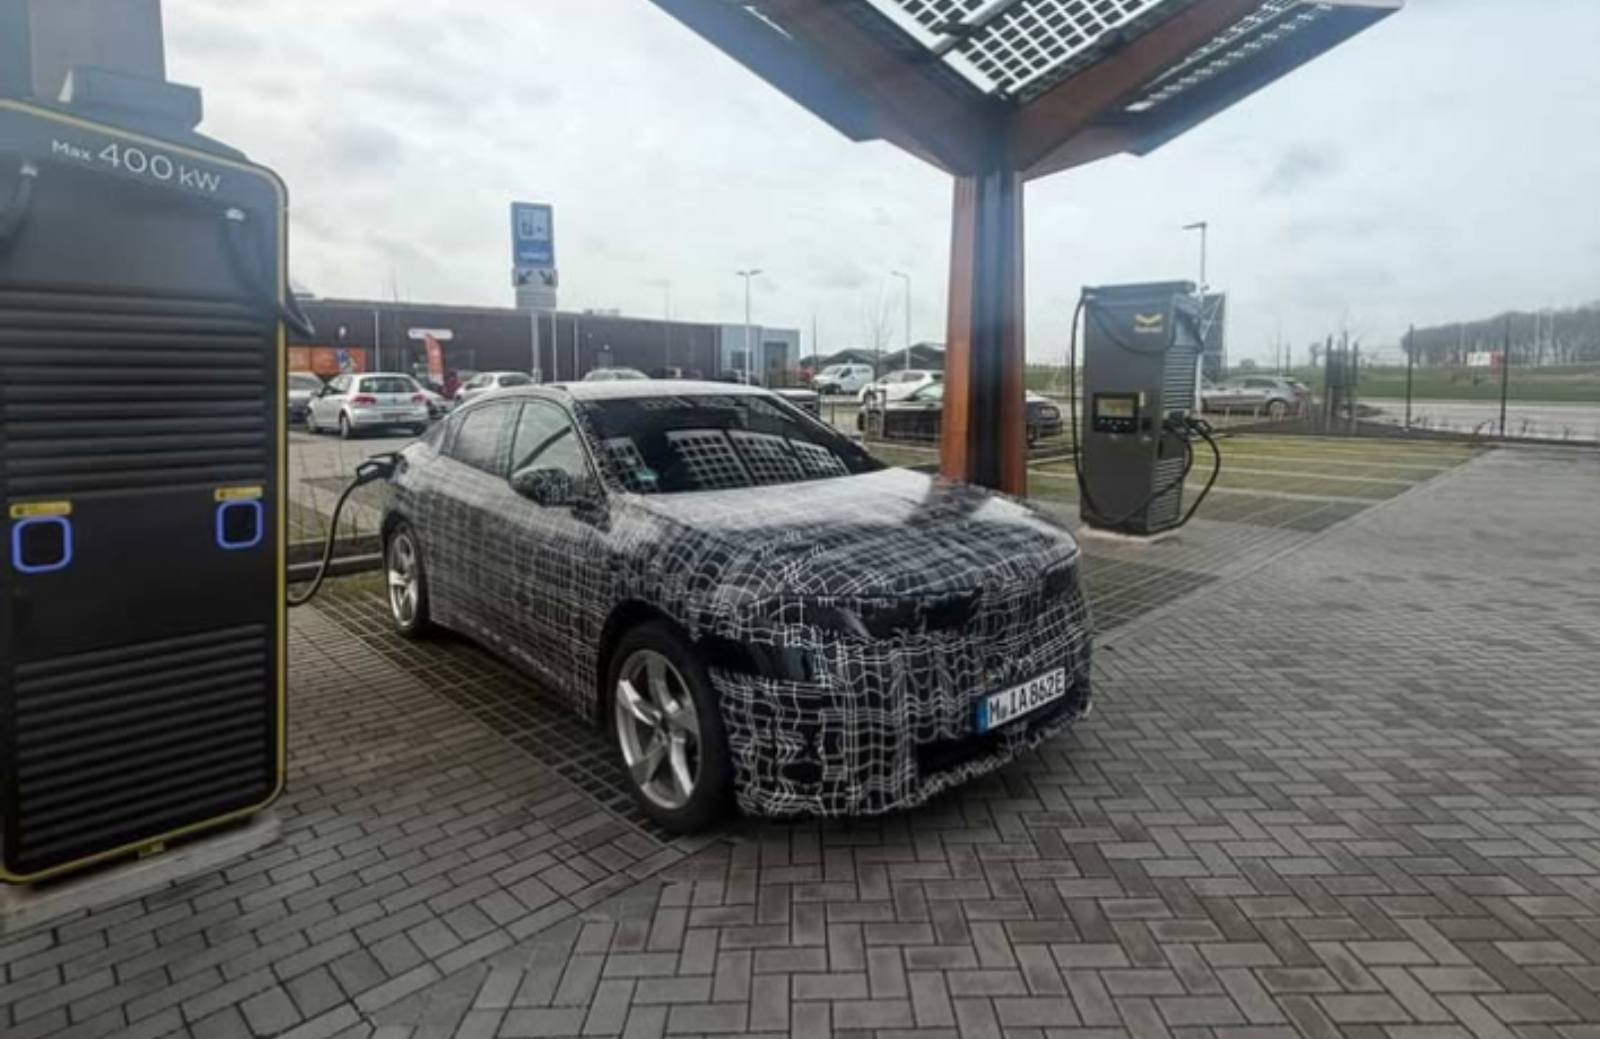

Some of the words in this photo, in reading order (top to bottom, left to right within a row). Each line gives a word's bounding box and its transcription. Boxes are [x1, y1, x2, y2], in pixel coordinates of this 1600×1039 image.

[52, 139, 91, 160] Max
[99, 143, 173, 180] 400
[180, 165, 220, 191] kW
